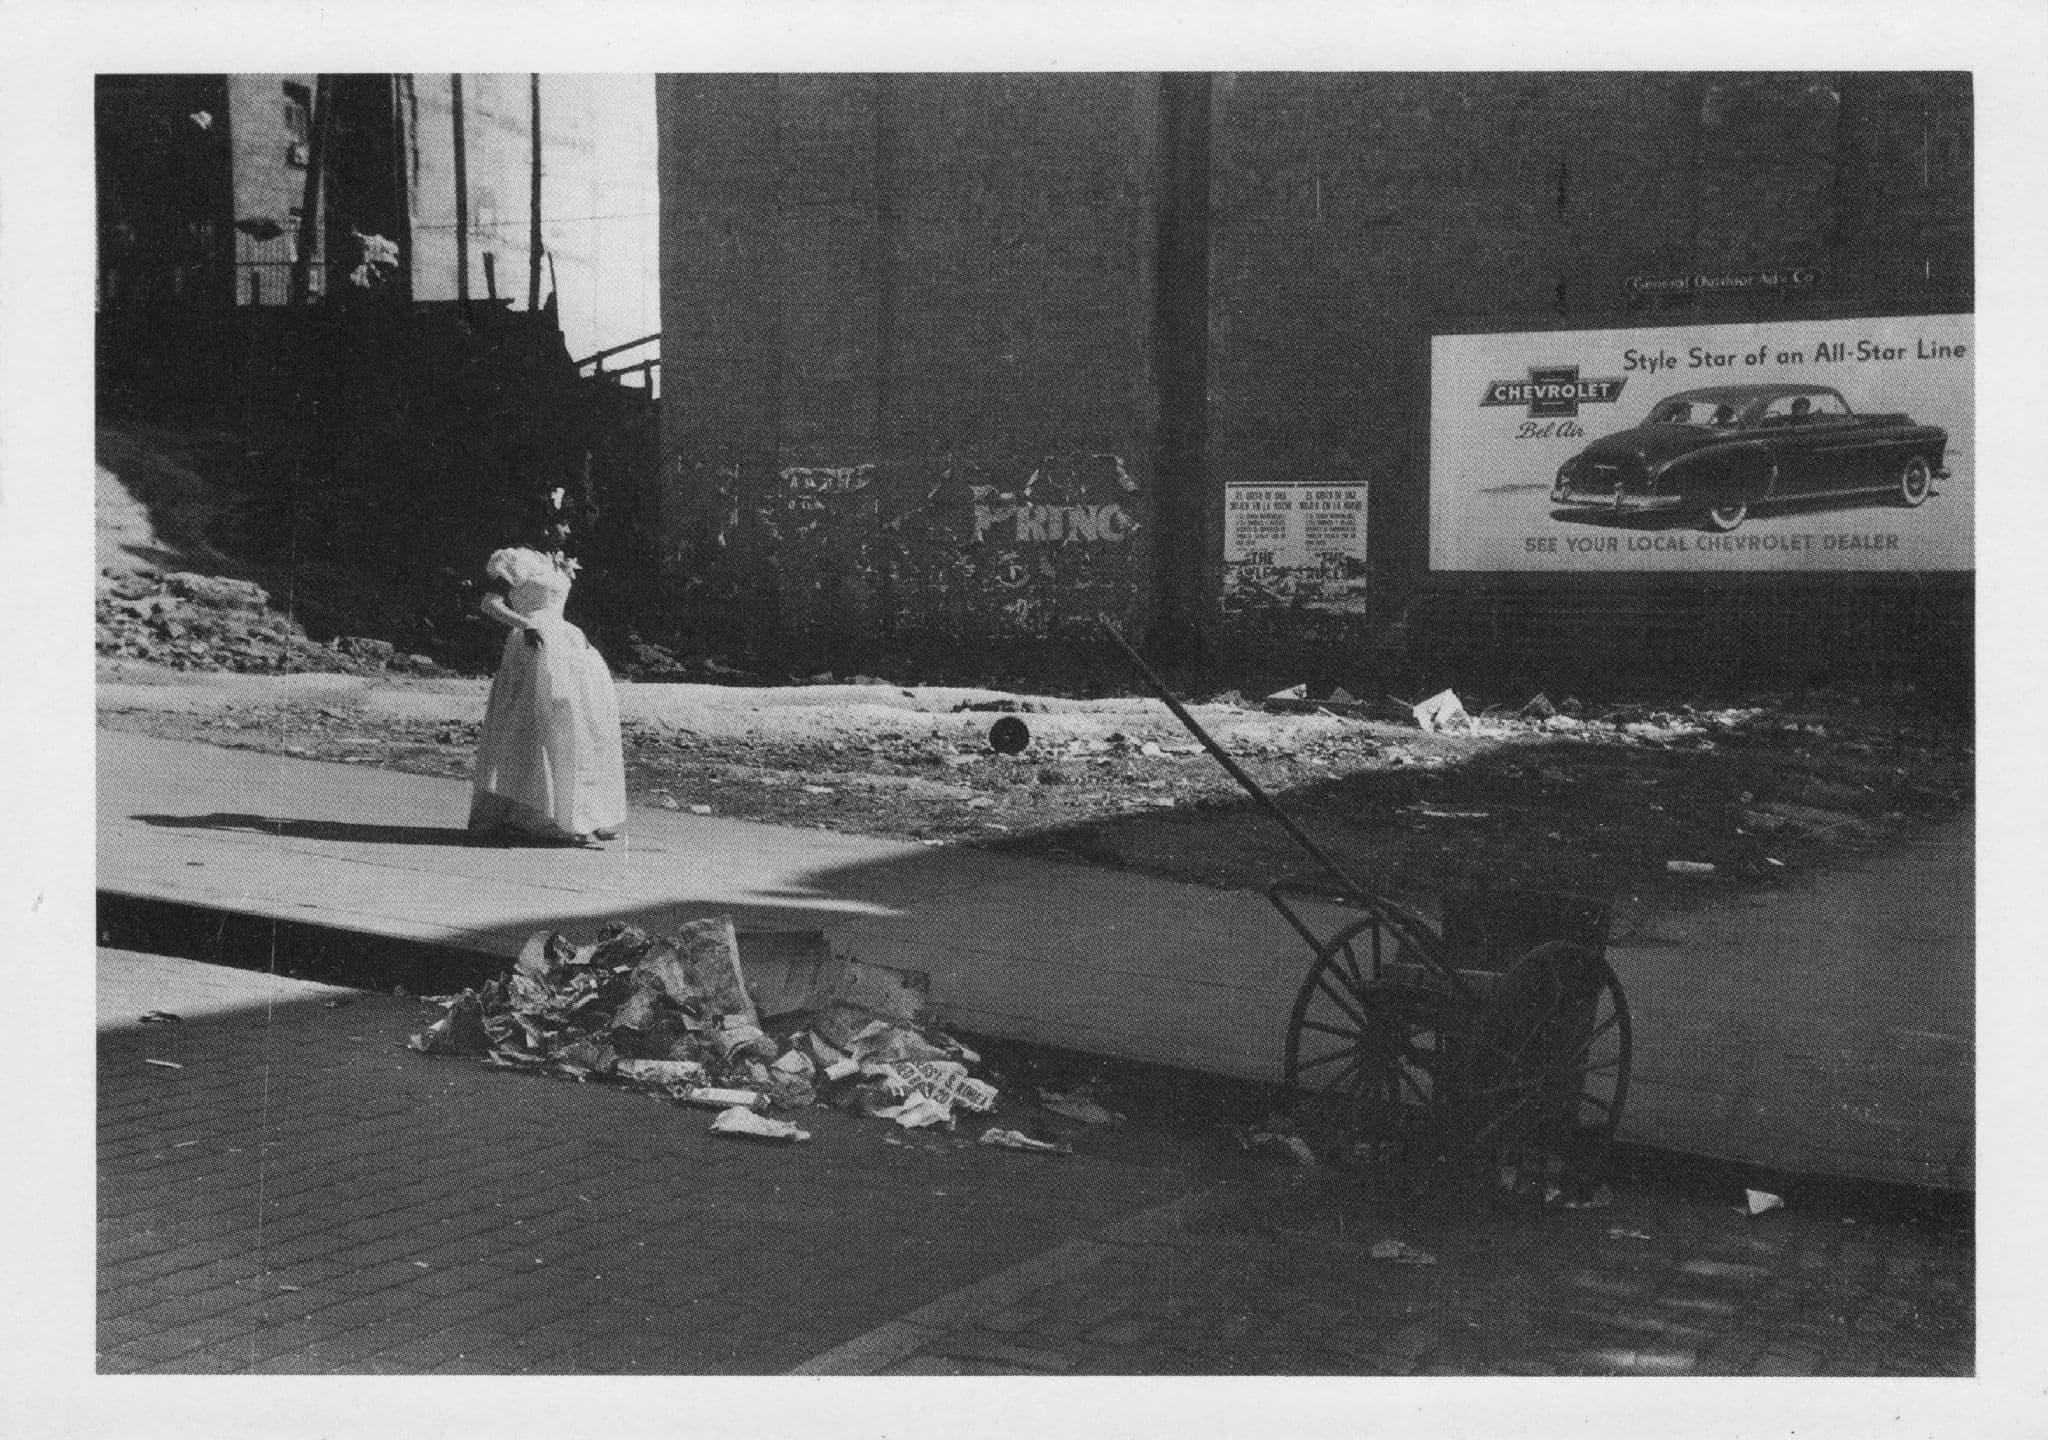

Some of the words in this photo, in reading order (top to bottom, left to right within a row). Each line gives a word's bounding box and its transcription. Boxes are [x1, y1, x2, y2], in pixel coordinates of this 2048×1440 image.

[1623, 349, 1677, 373] Style
[1688, 347, 1735, 368] Star
[1745, 346, 1768, 366] of
[1777, 349, 1804, 366] an
[1814, 341, 1906, 362] All-Star
[1917, 338, 1966, 360] Line
[1494, 382, 1610, 402] CHEVROLET
[1517, 421, 1551, 441] Bel
[1552, 421, 1585, 440] Air
[1525, 537, 1558, 553] SEE
[1567, 535, 1618, 553] YOUR
[1627, 534, 1688, 552] LOCAL
[1696, 534, 1812, 551] CHEVROLET
[1822, 533, 1899, 551] DEALER
